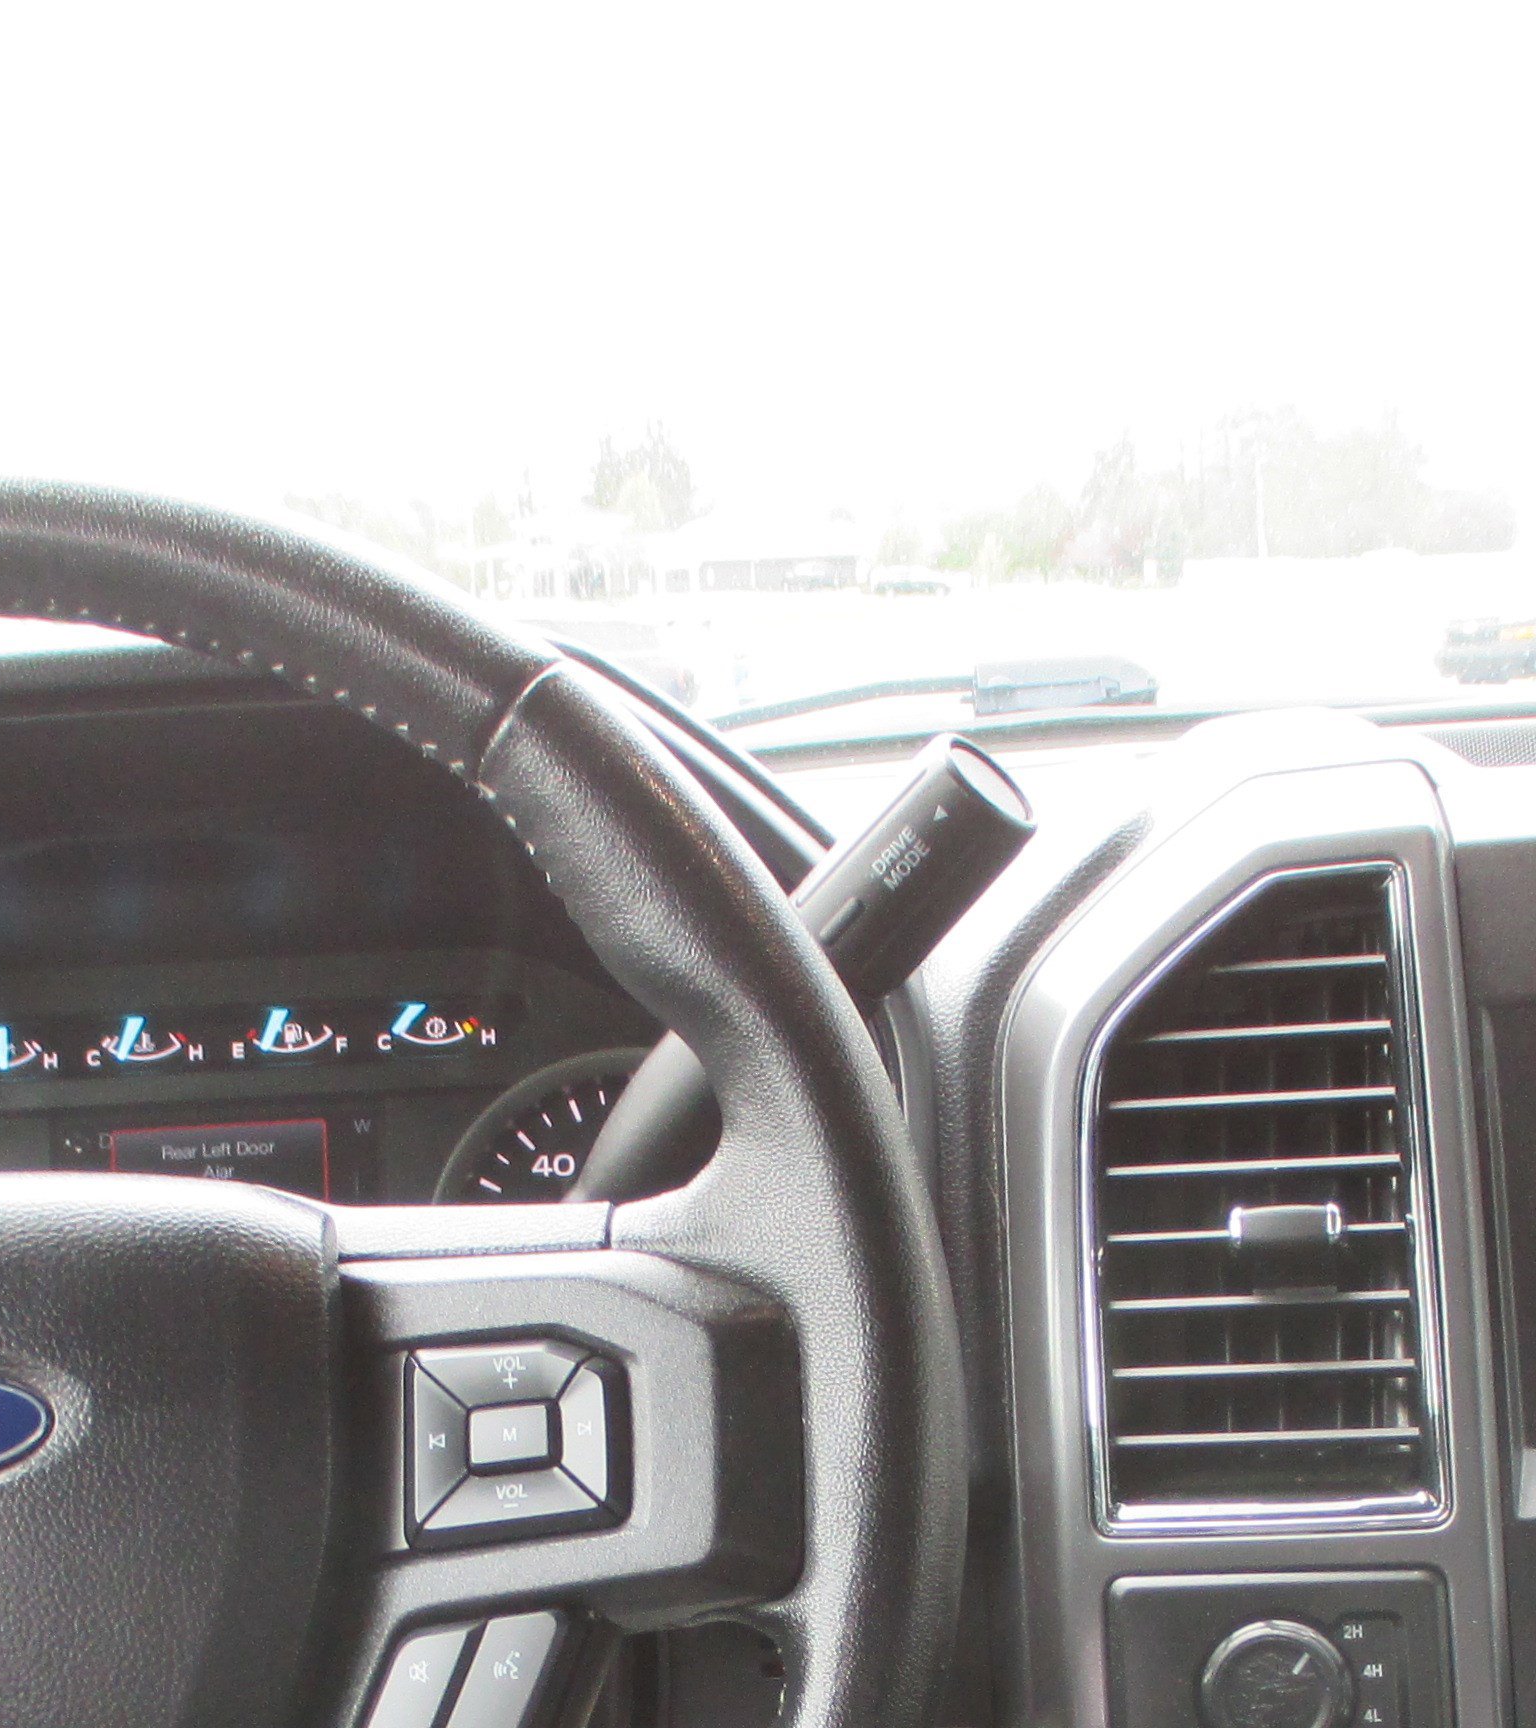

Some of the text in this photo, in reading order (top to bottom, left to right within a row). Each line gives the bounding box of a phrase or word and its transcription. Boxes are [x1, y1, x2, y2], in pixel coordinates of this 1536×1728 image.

[871, 825, 916, 876] DRIVE
[883, 839, 931, 892] MODE
[335, 1036, 349, 1053] F
[377, 1034, 392, 1050] C
[481, 1028, 496, 1046] H
[86, 1049, 101, 1066] C
[188, 1043, 204, 1061] H
[231, 1041, 245, 1059] E
[43, 1052, 59, 1070] H
[161, 1139, 275, 1161] Rear Left Door
[530, 1153, 576, 1178] 40
[492, 1355, 527, 1373] VOL
[502, 1427, 517, 1442] M
[495, 1483, 528, 1500] VOL
[1343, 1624, 1364, 1639] 2H
[1363, 1664, 1384, 1679] 4H
[1363, 1709, 1383, 1723] 4L
